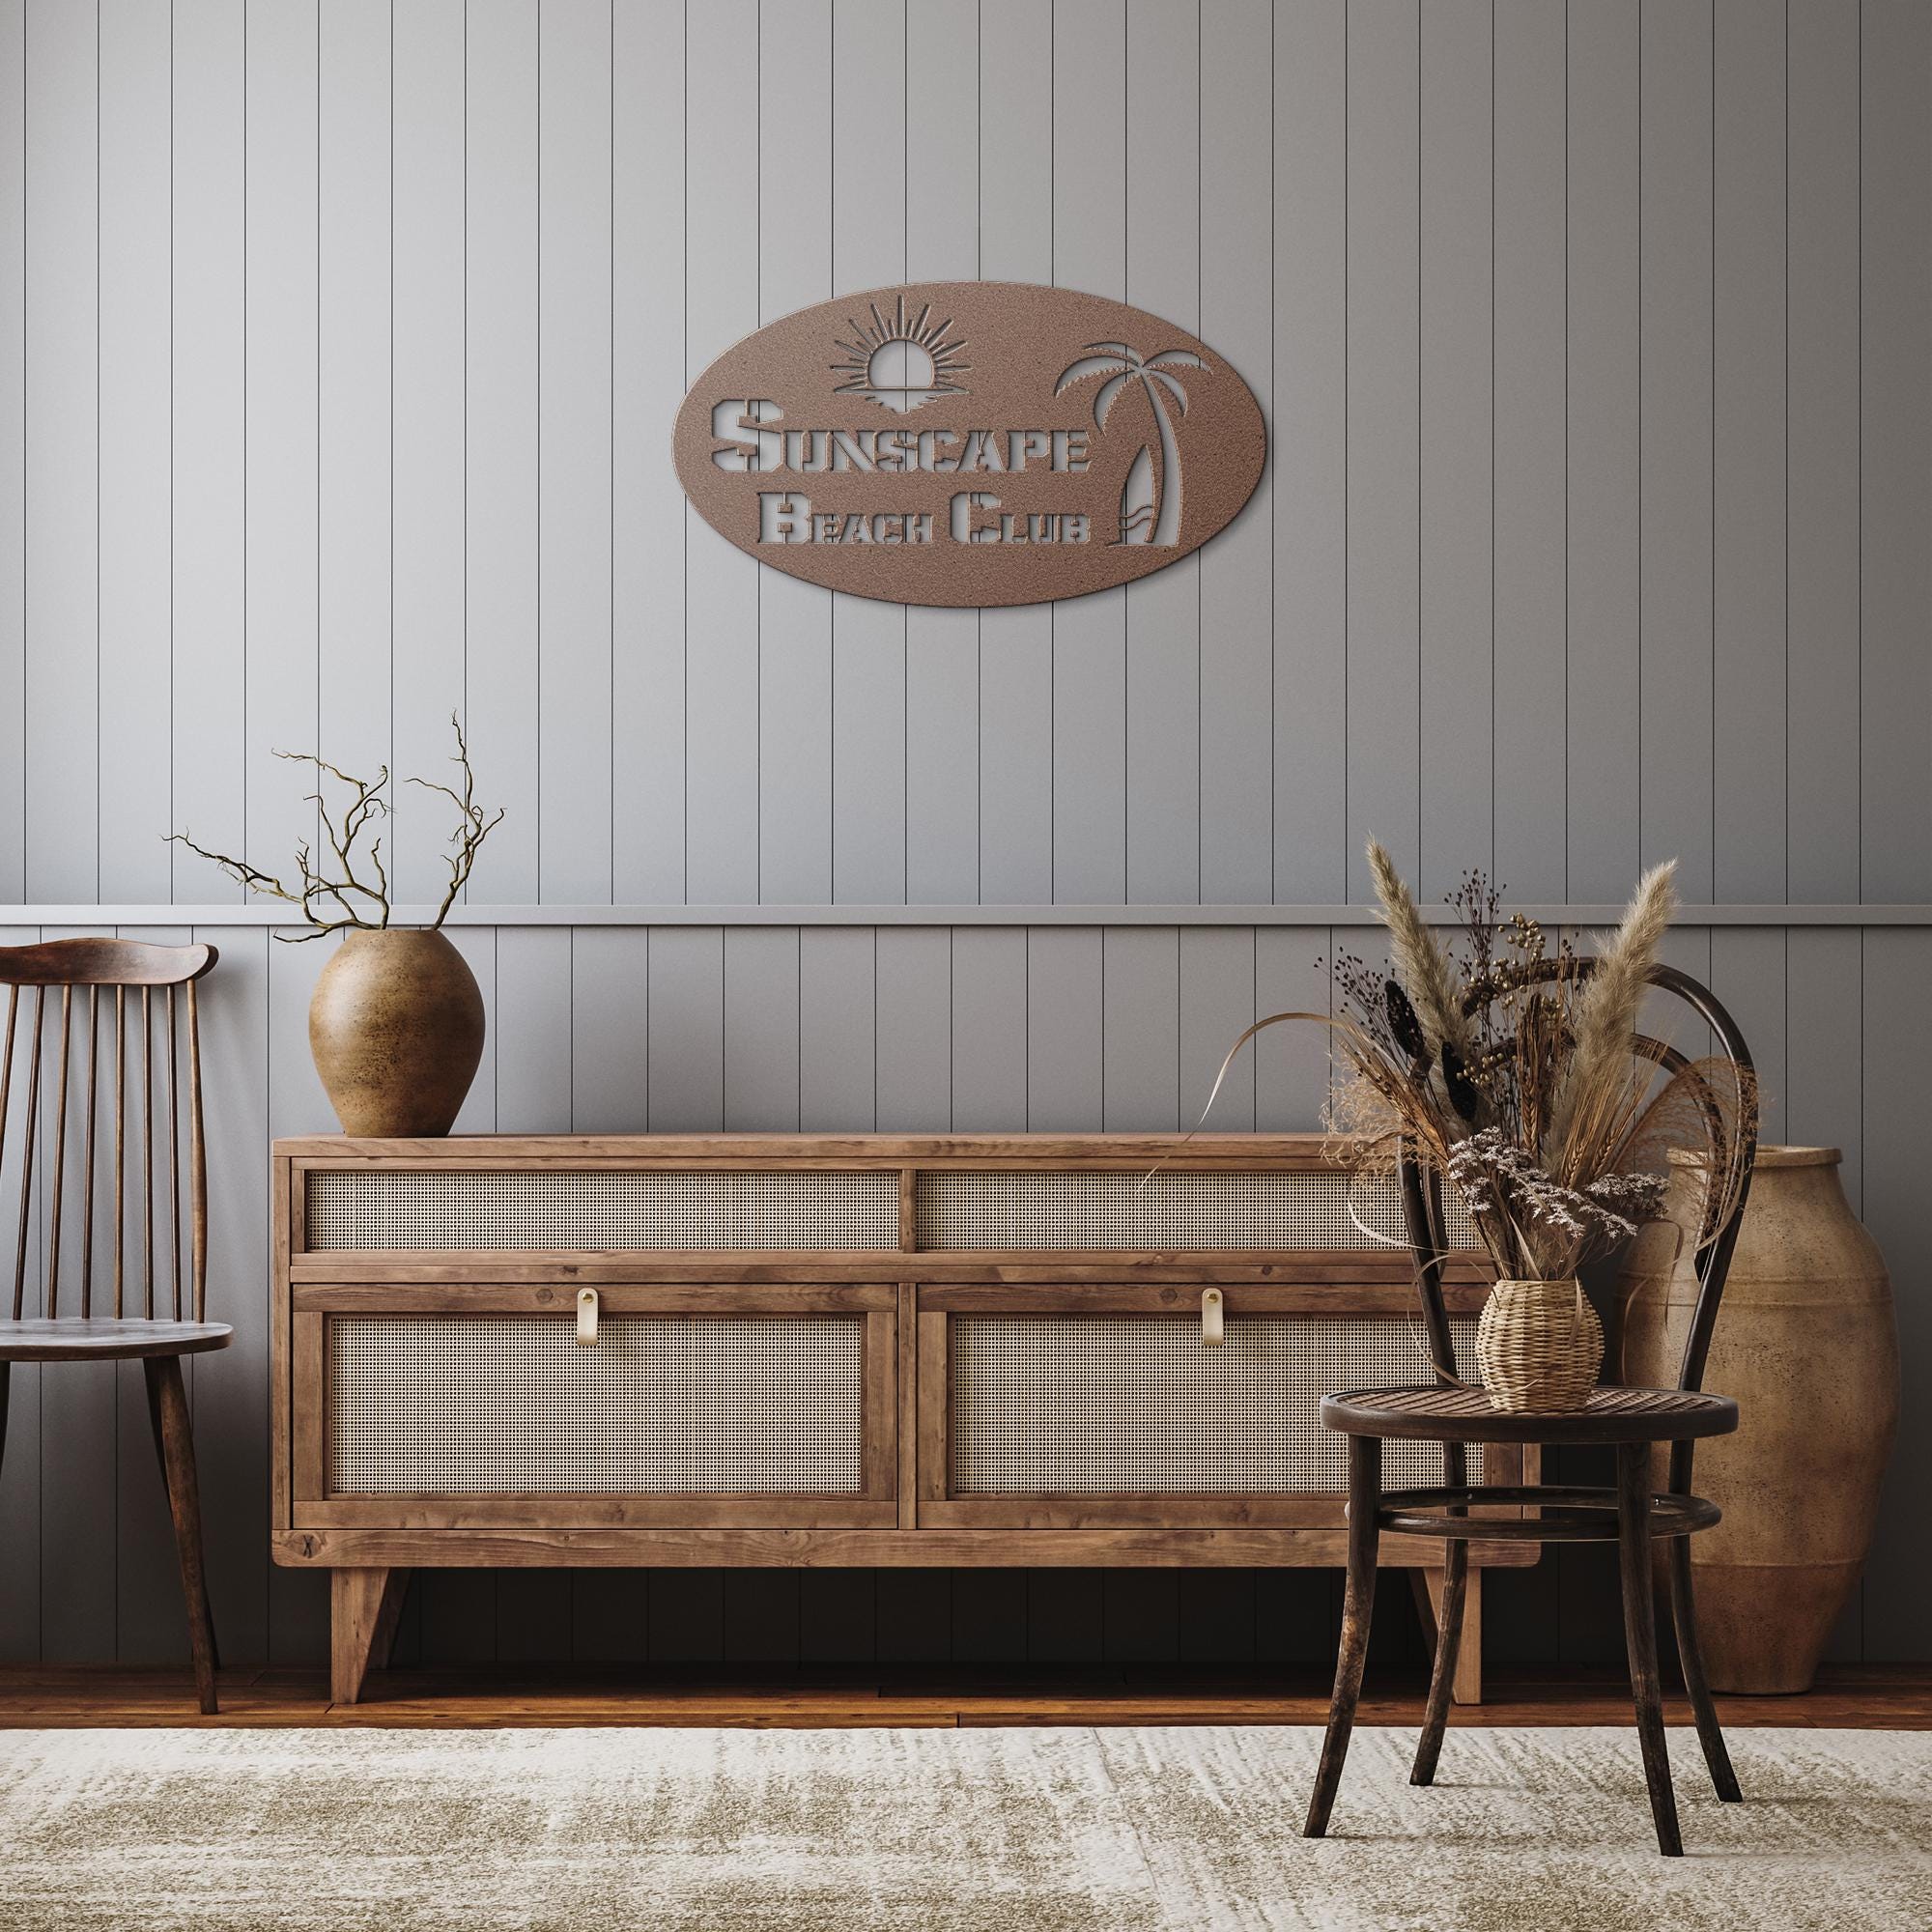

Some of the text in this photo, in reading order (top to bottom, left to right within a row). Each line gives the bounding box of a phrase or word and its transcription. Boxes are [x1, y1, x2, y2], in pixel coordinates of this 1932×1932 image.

[712, 398, 1092, 472] SUNSCAPE
[756, 492, 1091, 544] BEACH CLUB
